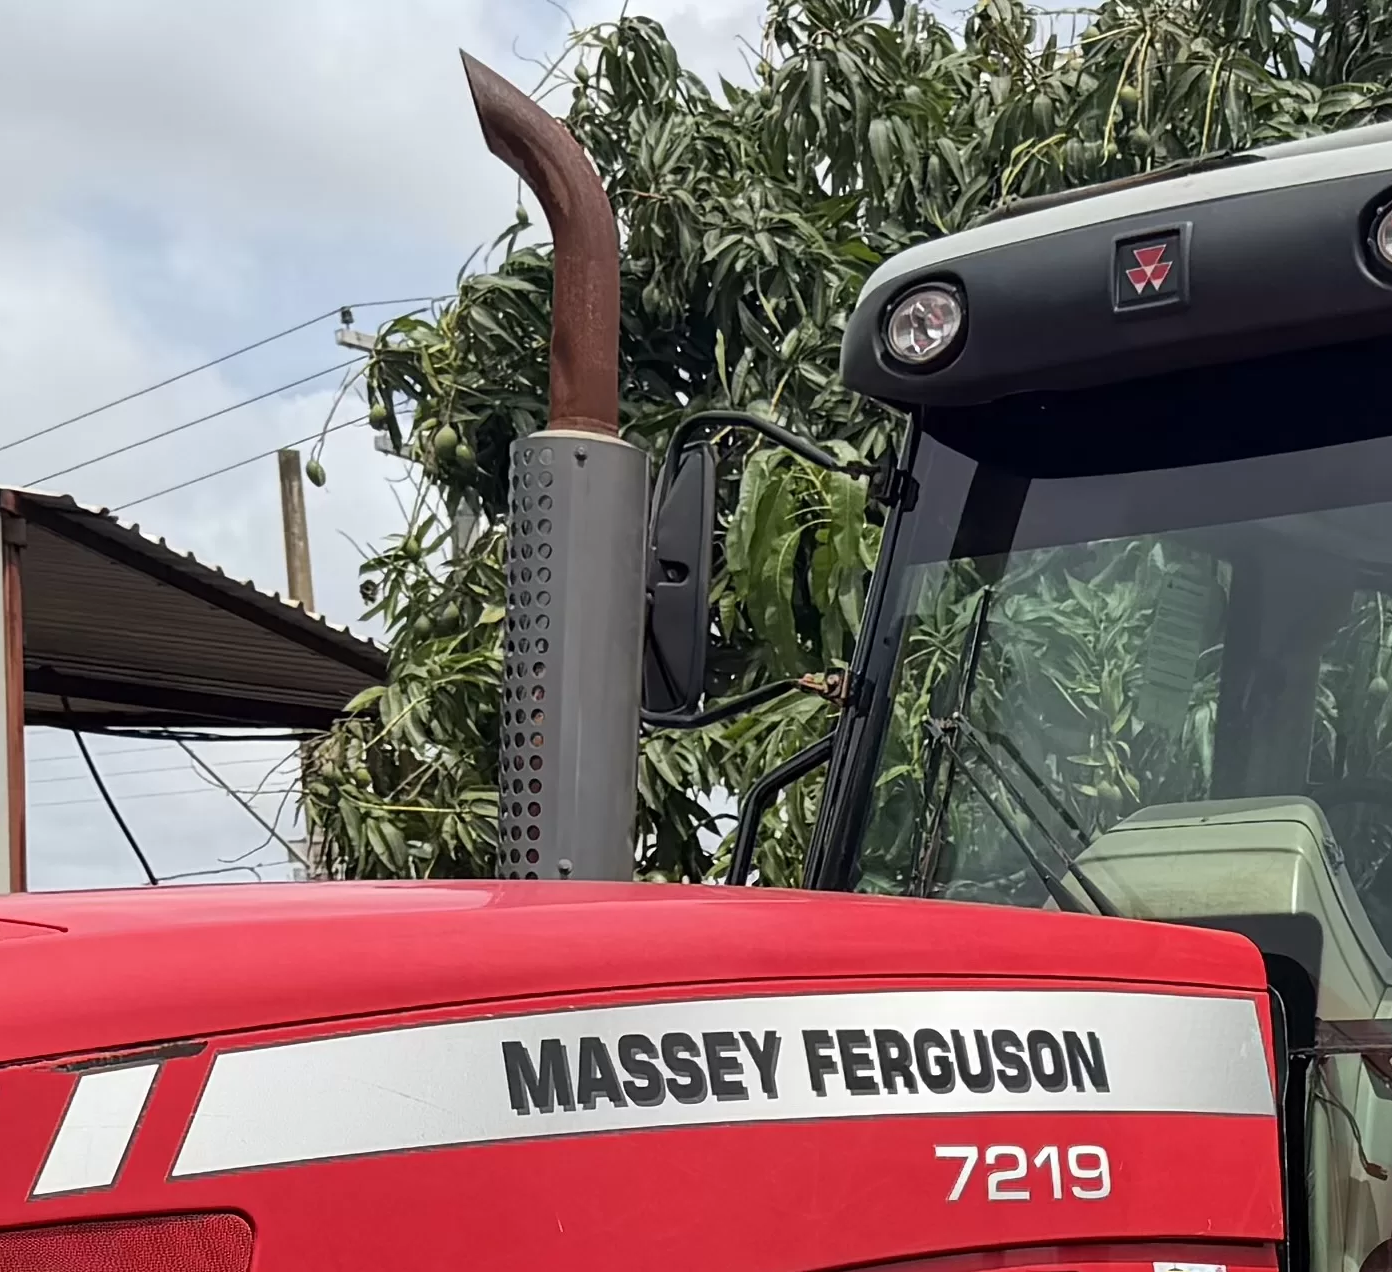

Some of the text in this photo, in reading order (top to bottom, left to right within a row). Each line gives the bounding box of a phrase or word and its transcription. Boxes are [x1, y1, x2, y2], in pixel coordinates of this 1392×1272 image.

[502, 1028, 1111, 1116] MASSEY FERGUSON
[934, 1144, 1112, 1202] 7219
